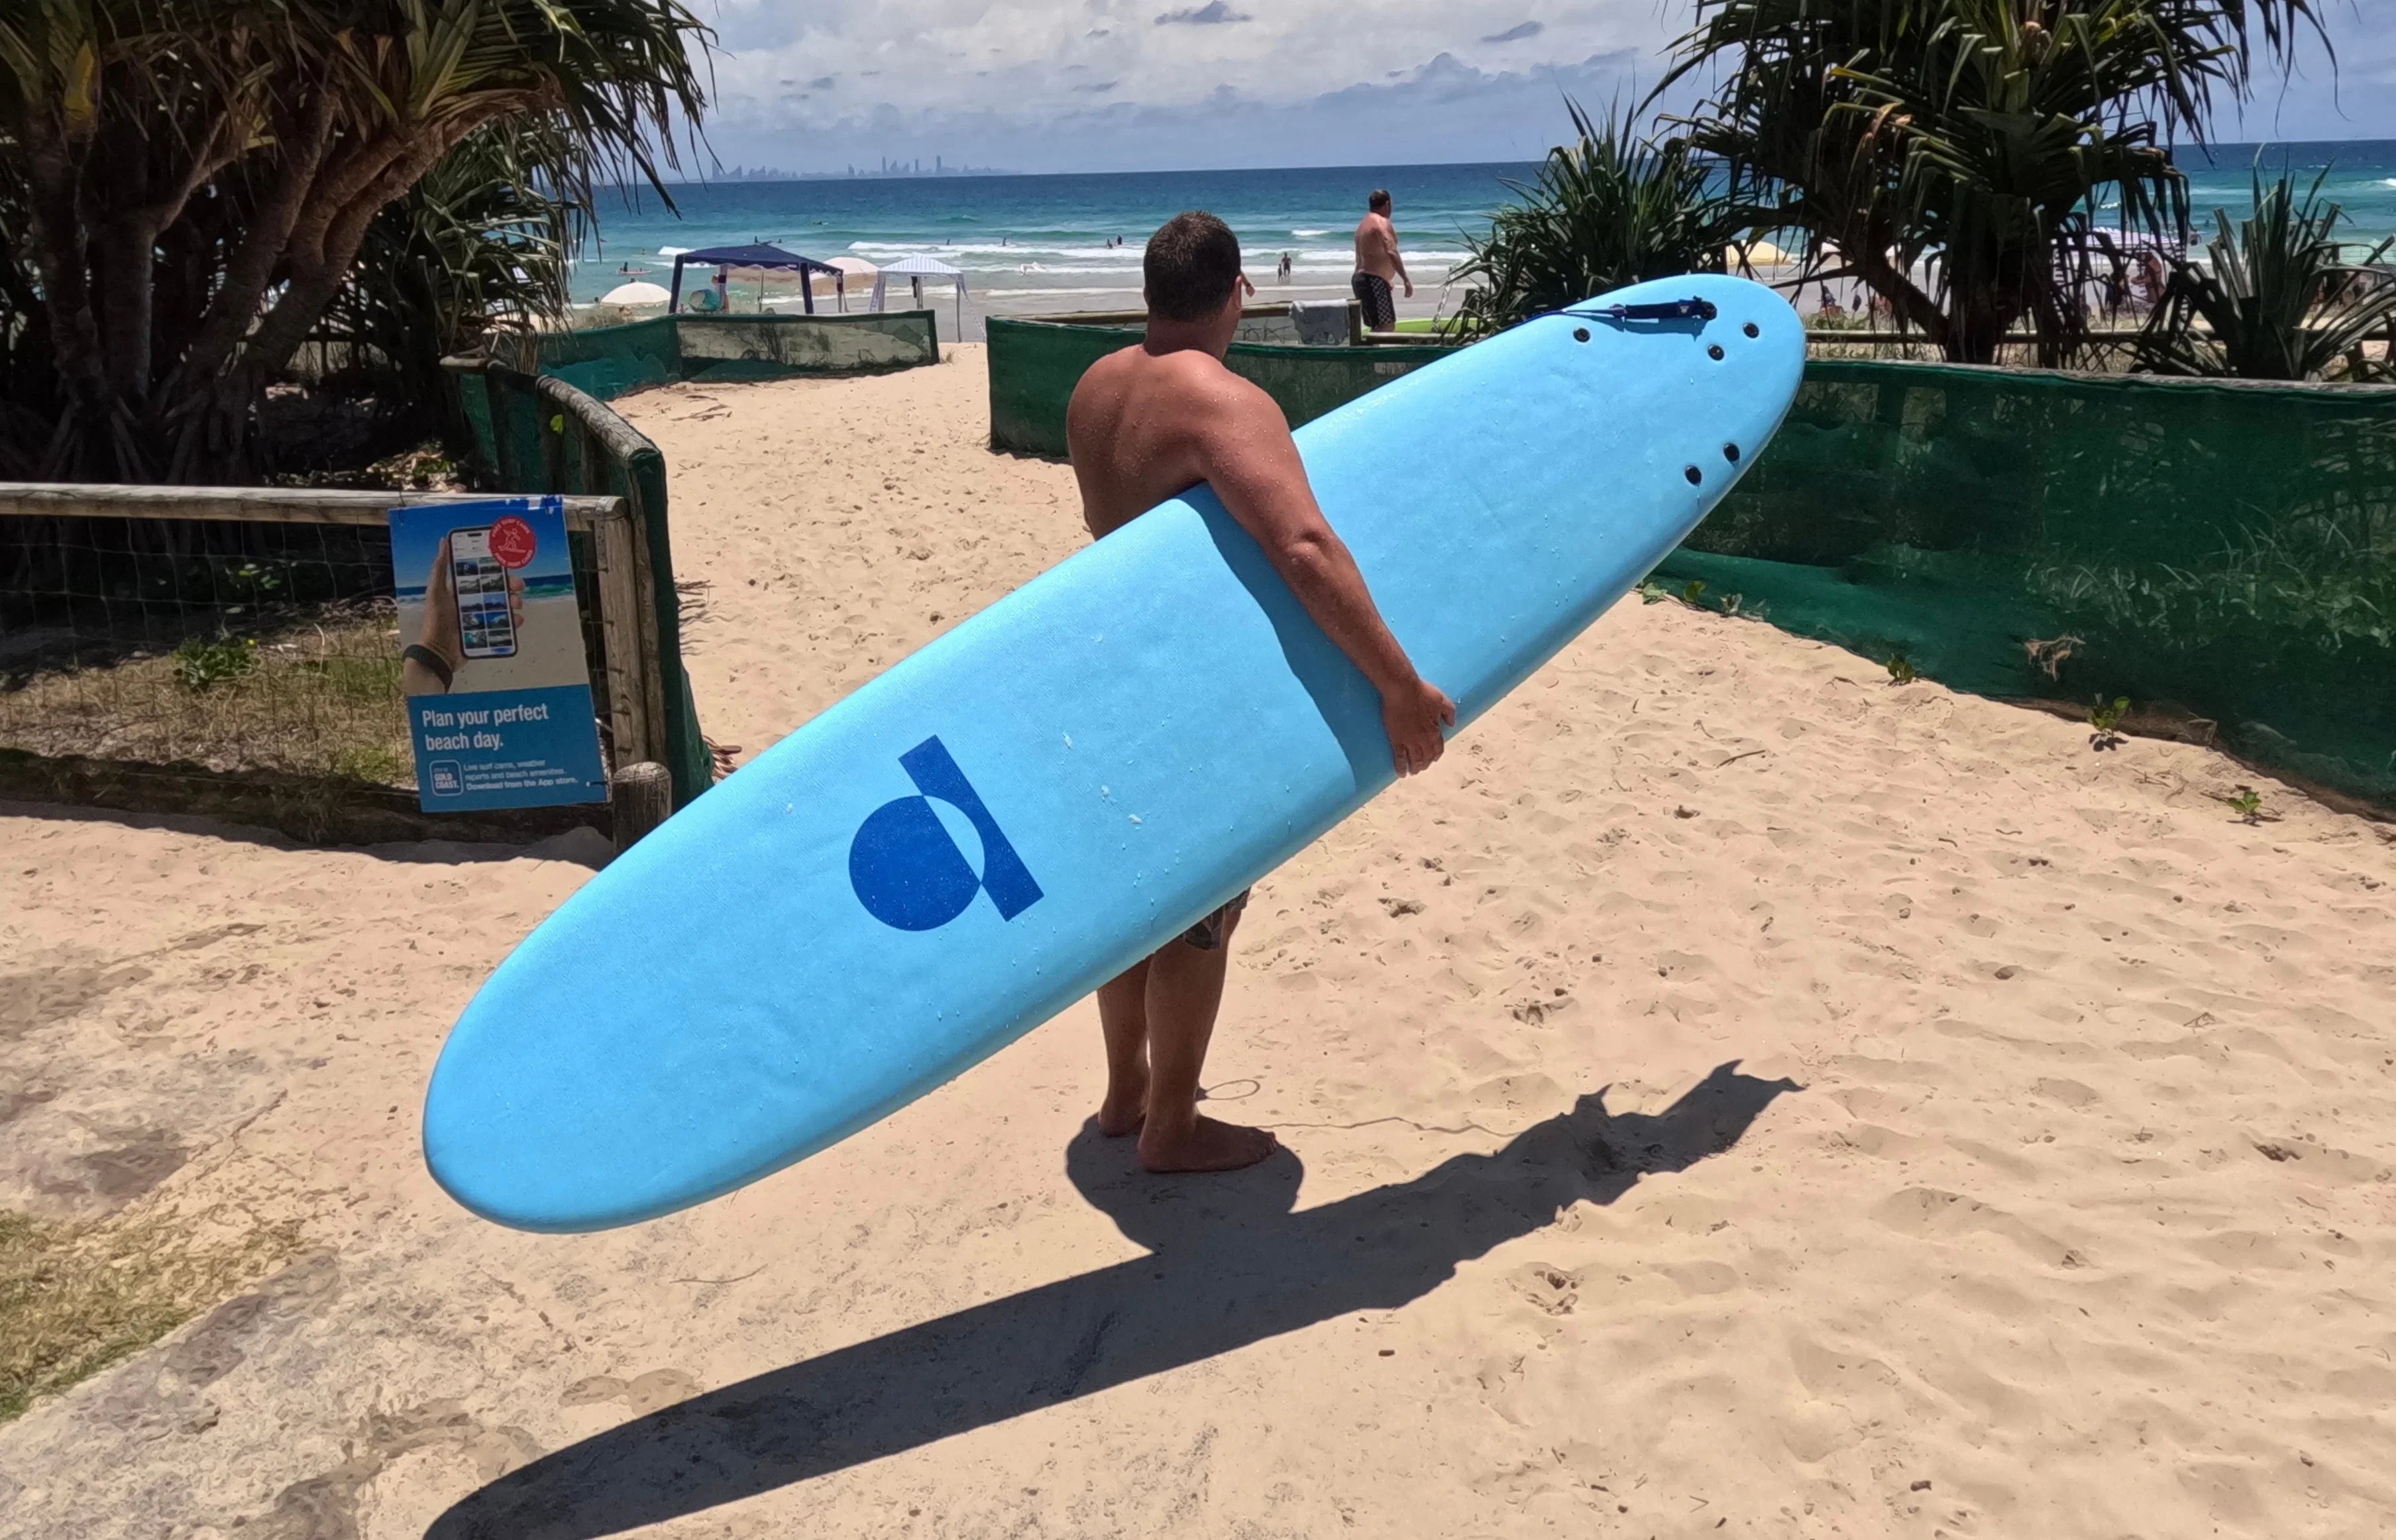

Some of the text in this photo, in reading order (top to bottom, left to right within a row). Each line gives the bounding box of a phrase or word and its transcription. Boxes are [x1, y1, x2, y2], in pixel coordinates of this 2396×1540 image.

[422, 702, 549, 729] Plan your perfect
[425, 731, 504, 751] beach day.
